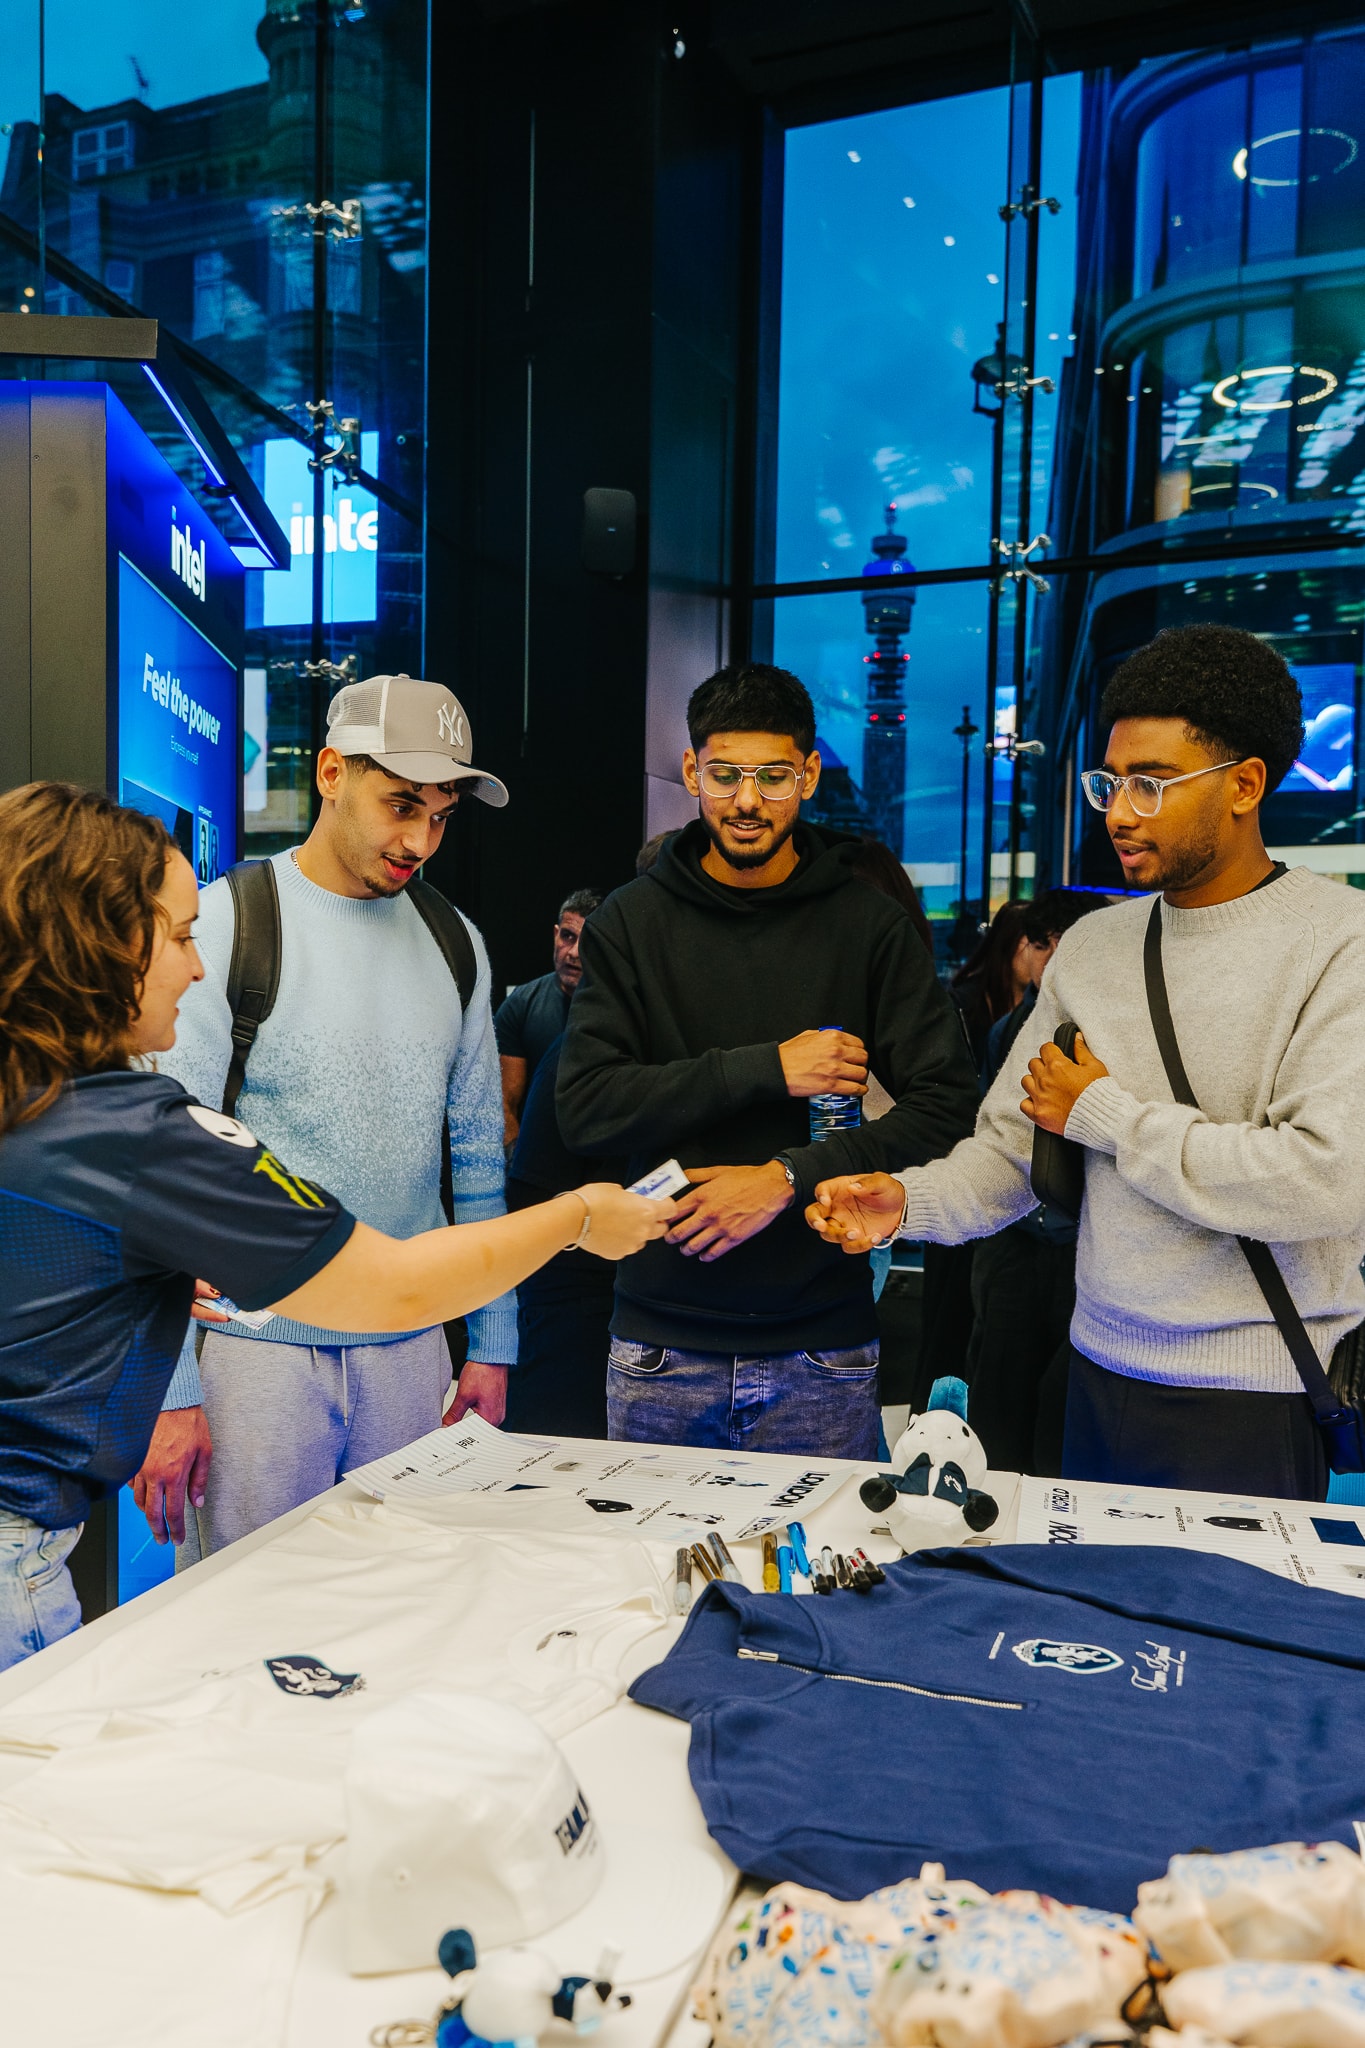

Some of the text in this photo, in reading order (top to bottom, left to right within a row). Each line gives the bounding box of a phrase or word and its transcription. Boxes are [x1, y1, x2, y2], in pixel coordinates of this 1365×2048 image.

[290, 499, 378, 555] inte
[171, 505, 206, 602] intel
[142, 652, 221, 745] Feel the power
[437, 703, 464, 747] NY
[770, 1472, 831, 1508] LONDON
[1051, 1488, 1070, 1513] WORLD
